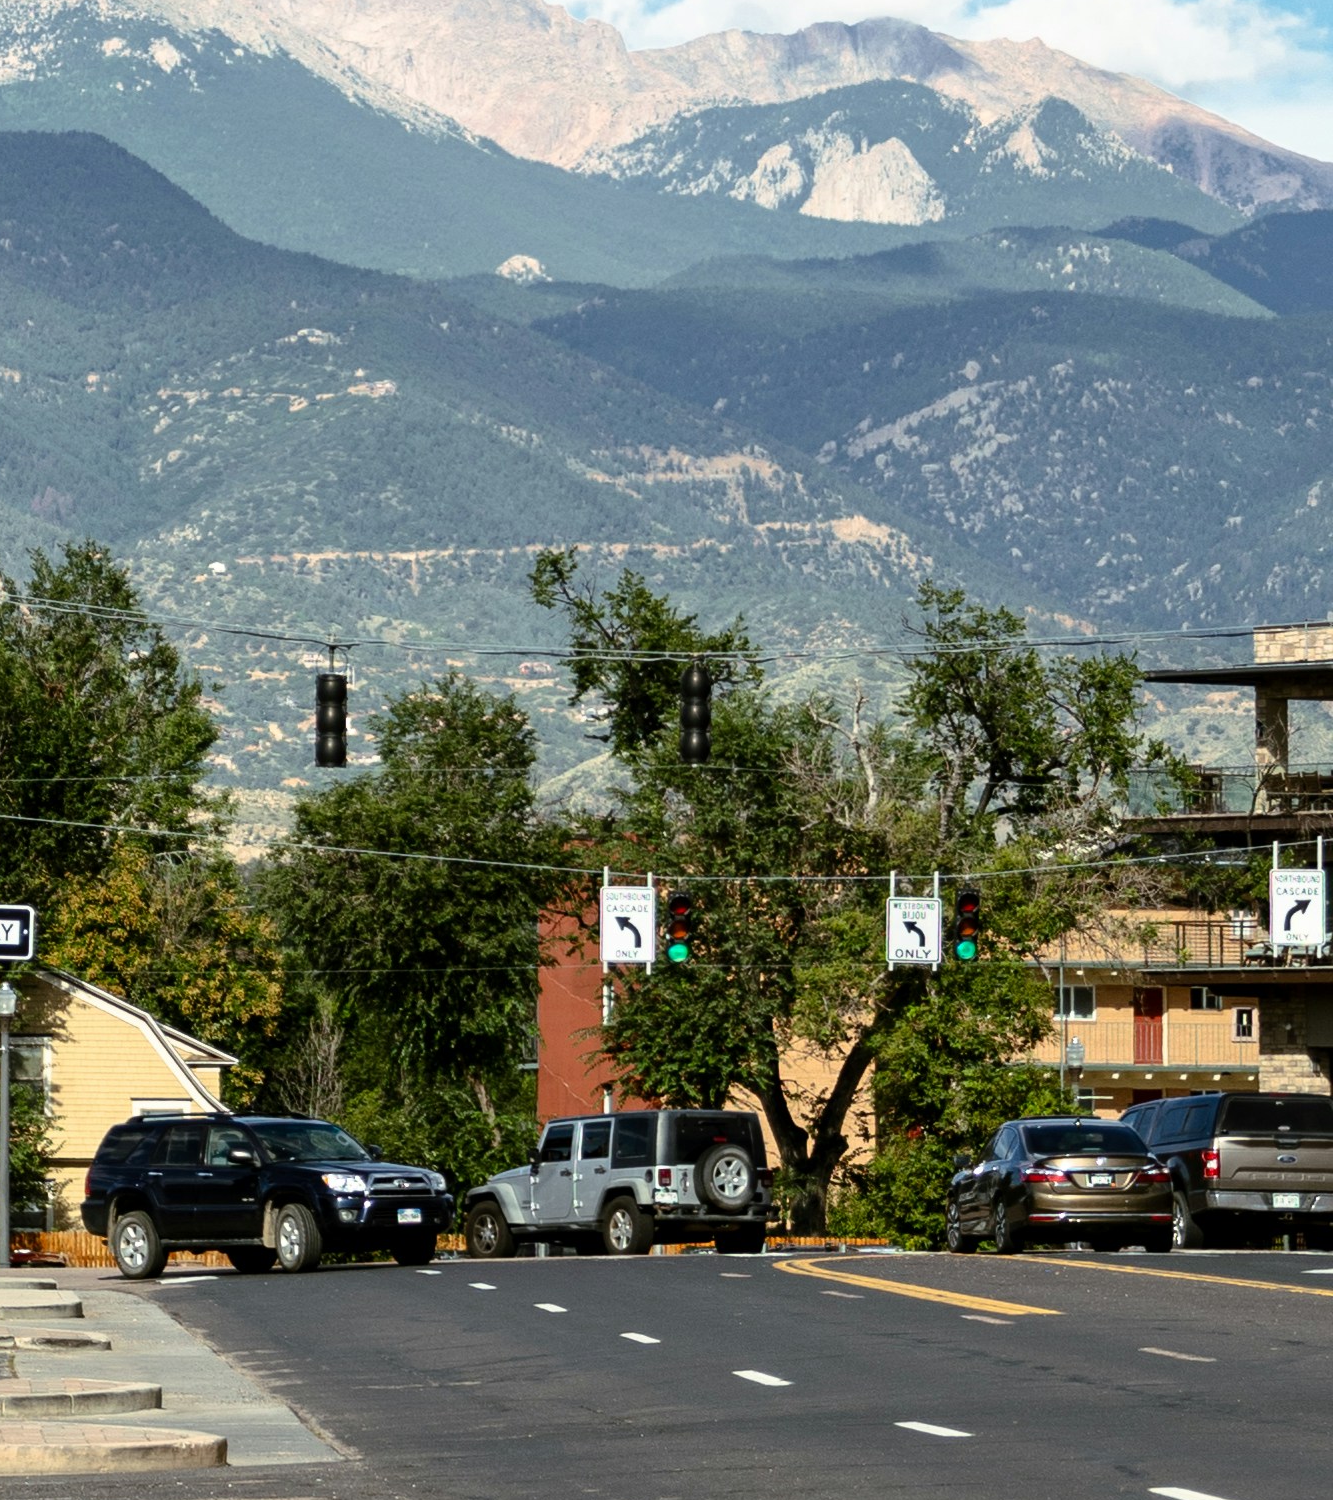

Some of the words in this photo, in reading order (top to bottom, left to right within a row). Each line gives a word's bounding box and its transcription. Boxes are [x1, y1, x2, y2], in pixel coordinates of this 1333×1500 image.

[1274, 874, 1321, 884] NORTHBOUND
[1276, 887, 1320, 896] CASCADE
[605, 892, 651, 901] SOUTHBOUND
[606, 904, 649, 913] CASCADE
[893, 902, 936, 911] WESTBOUND
[901, 910, 927, 920] BIJOU
[1286, 933, 1309, 941] ONLY
[615, 949, 639, 959] ONLY
[894, 948, 932, 959] ONLY
